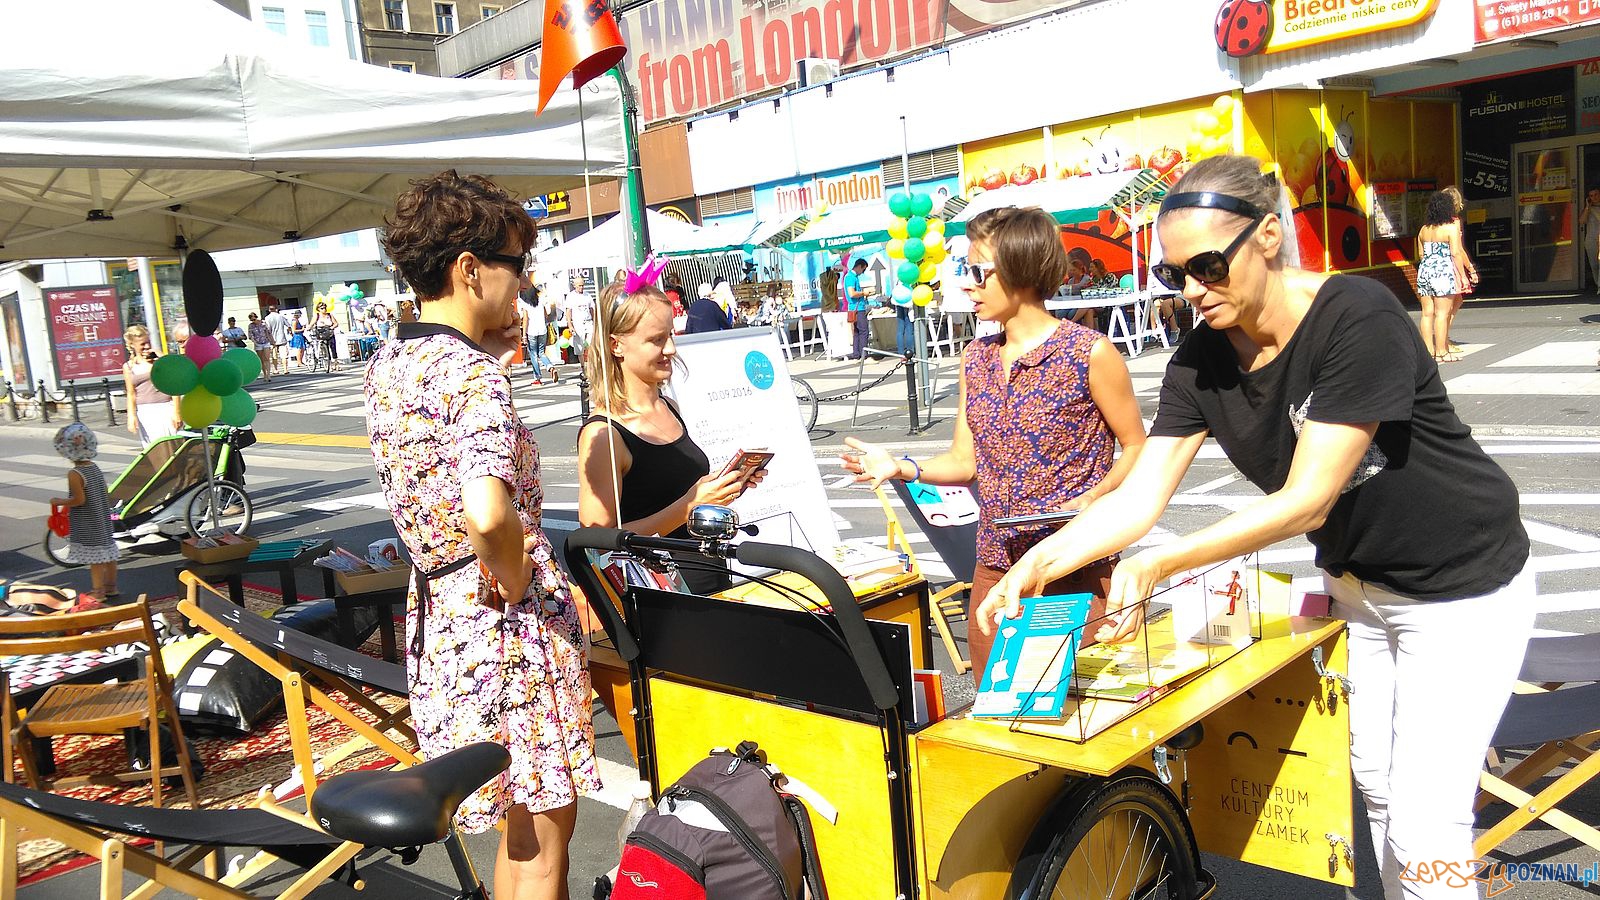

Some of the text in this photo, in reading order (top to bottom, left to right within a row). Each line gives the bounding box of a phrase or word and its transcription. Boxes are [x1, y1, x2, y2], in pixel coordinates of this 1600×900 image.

[1284, 0, 1422, 33] Codziennie niskie ceny
[1285, 0, 1373, 20] Biedr
[1501, 14, 1521, 30] (61)
[1521, 11, 1541, 24] 818
[1541, 8, 1555, 19] 28
[1556, 6, 1569, 16] 14
[638, 0, 933, 123] from London
[1469, 95, 1566, 117] FUSION HOSTEL
[776, 173, 882, 214] from London
[1473, 171, 1498, 189] 55
[1494, 183, 1508, 193] PLN
[60, 302, 107, 314] CZAS NA
[707, 386, 753, 402] 10.09.2016
[1230, 778, 1310, 808] CENTRUM
[1220, 794, 1295, 823] KULTURY
[1255, 819, 1310, 846] ZAMEK
